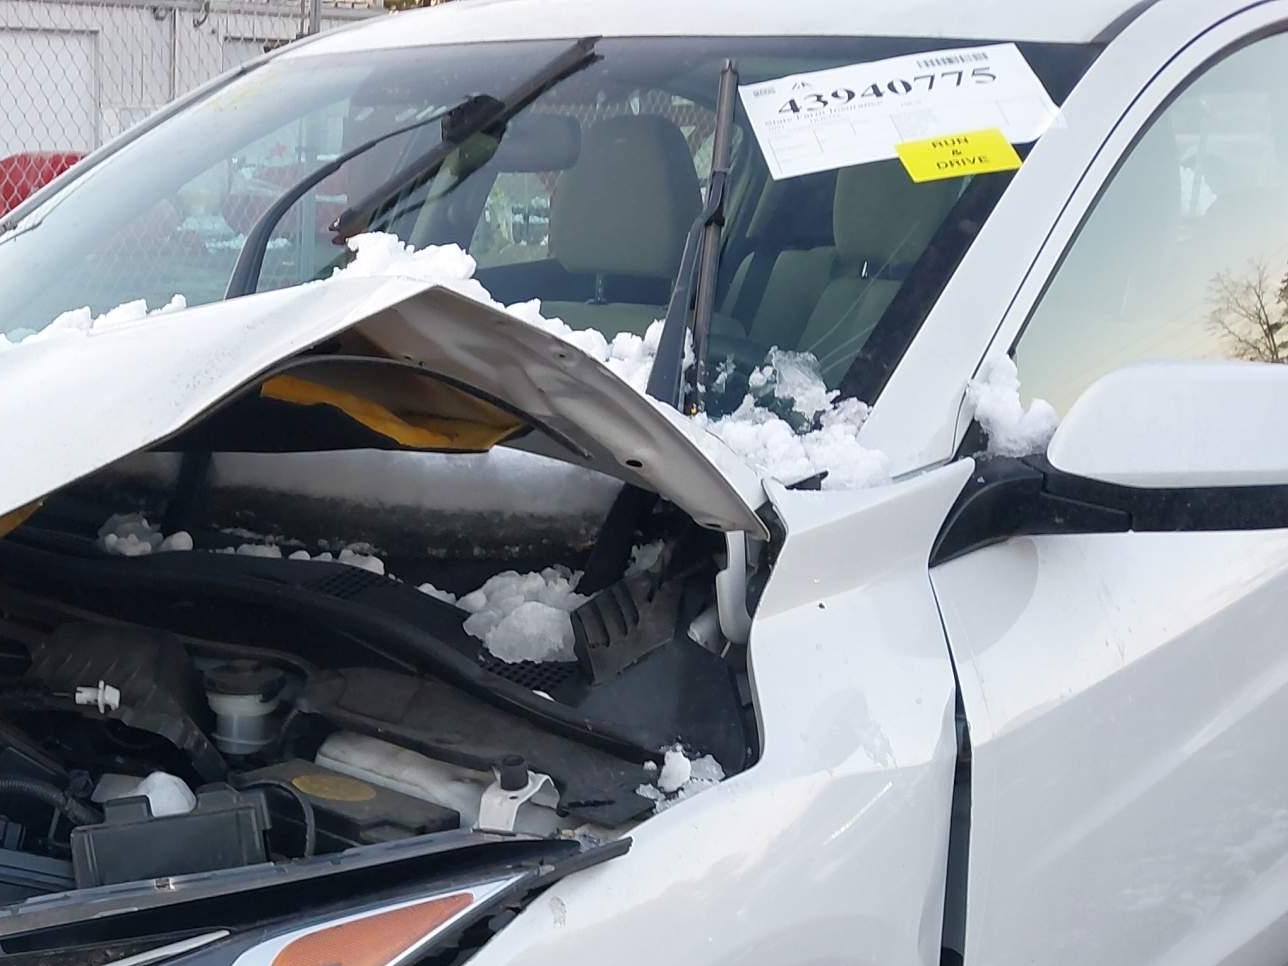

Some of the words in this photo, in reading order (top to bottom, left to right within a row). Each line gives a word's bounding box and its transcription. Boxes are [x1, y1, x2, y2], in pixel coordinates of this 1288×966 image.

[778, 66, 997, 114] 43940775
[931, 136, 969, 149] RUN
[936, 155, 990, 170] DRIVE
